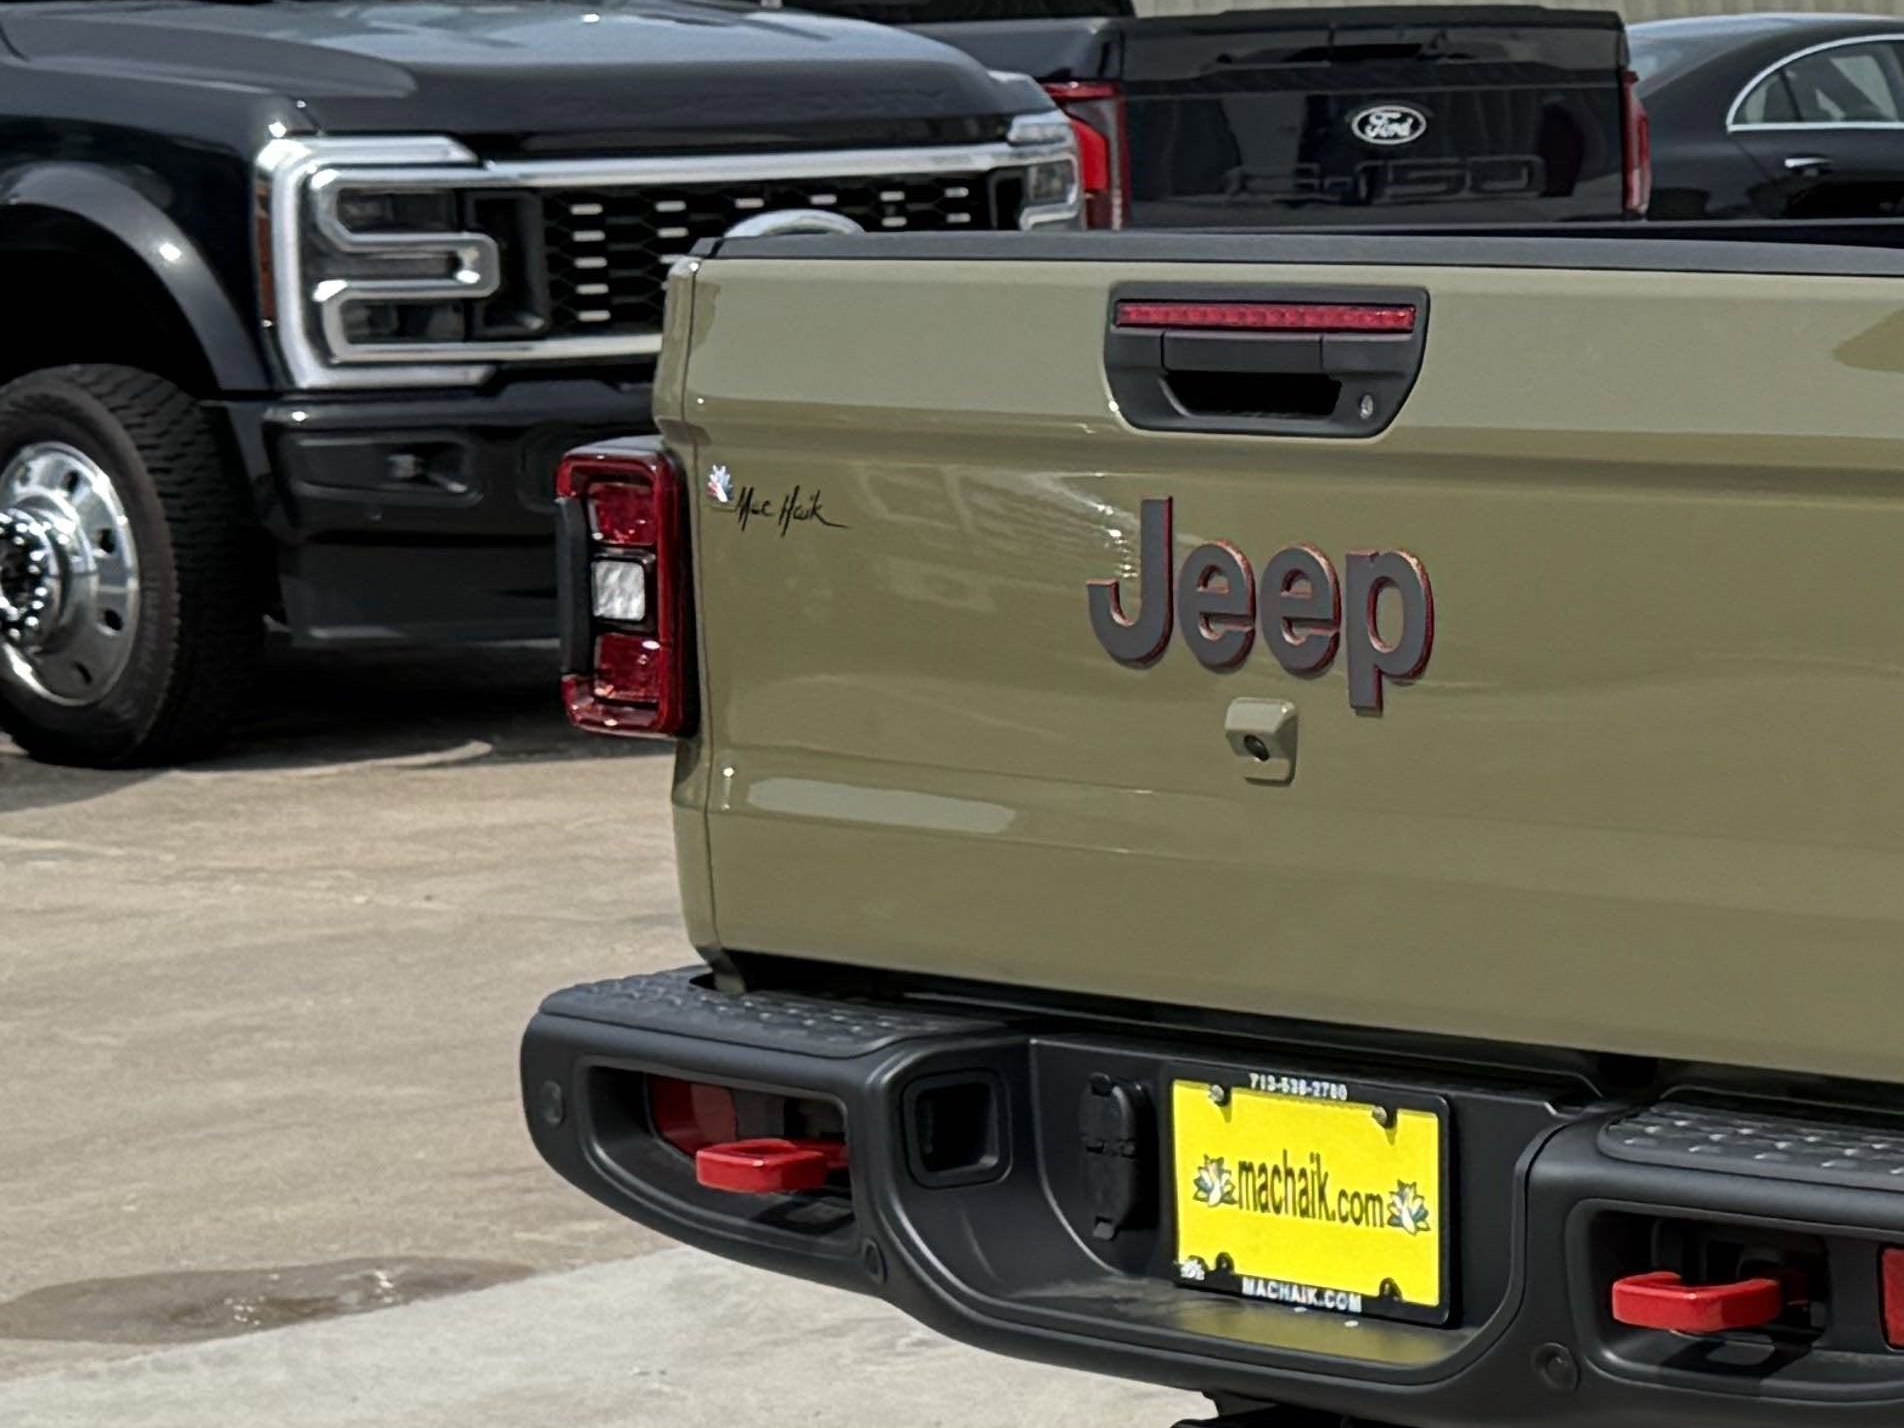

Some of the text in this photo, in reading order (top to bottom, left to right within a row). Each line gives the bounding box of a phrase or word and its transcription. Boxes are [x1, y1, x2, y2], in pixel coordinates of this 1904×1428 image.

[1363, 110, 1415, 139] Ford
[735, 485, 775, 532] Mac
[1086, 495, 1434, 716] Jeep
[1237, 1148, 1385, 1228] machaik.com
[1241, 1276, 1363, 1314] MACHAIK.COM
